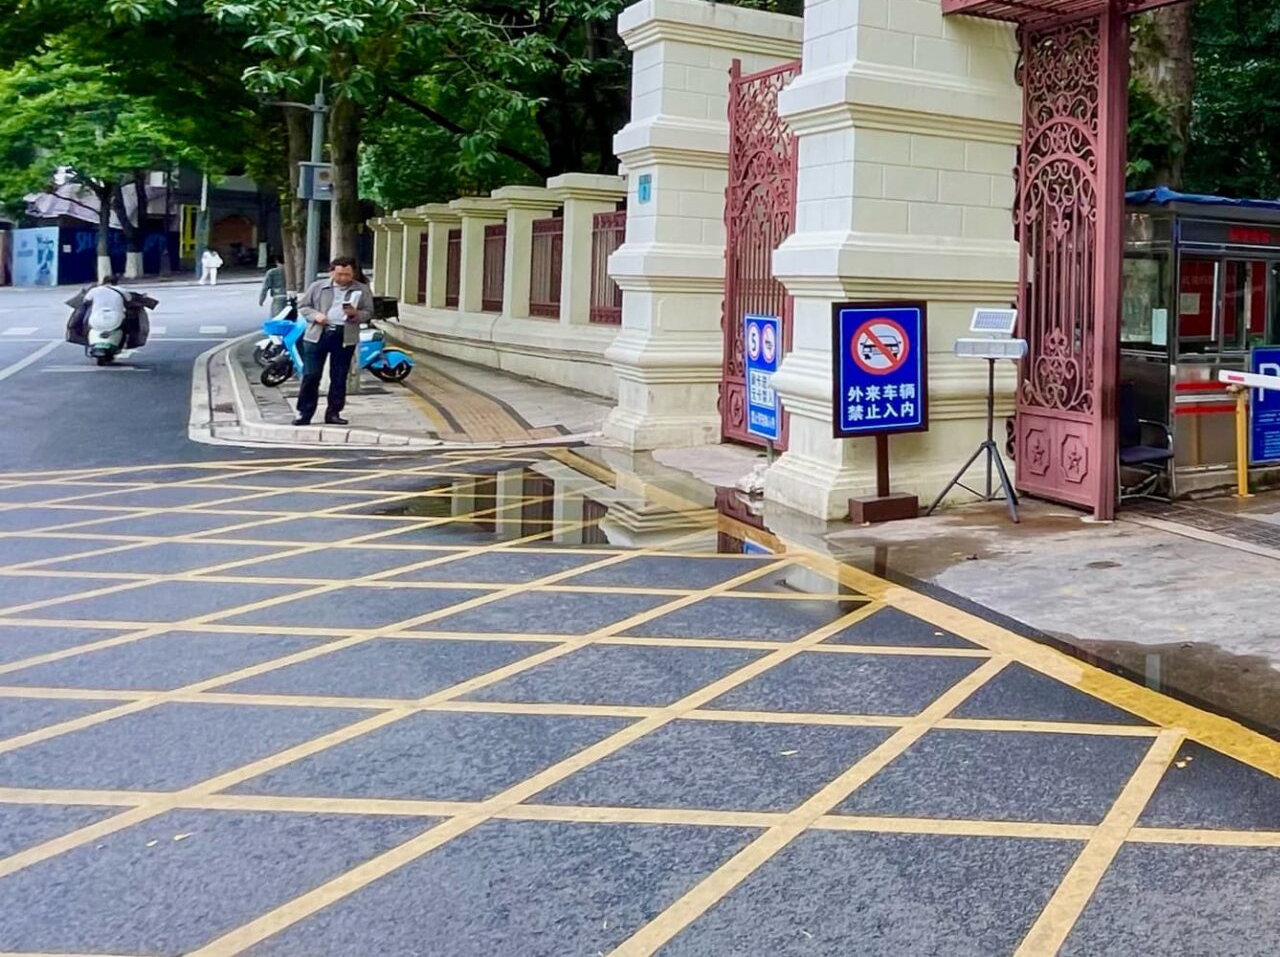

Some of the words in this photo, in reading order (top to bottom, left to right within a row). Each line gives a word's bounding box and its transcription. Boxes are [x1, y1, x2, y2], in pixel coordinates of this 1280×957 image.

[848, 383, 916, 403] 外来车辆
[847, 402, 915, 422] 禁止入内
